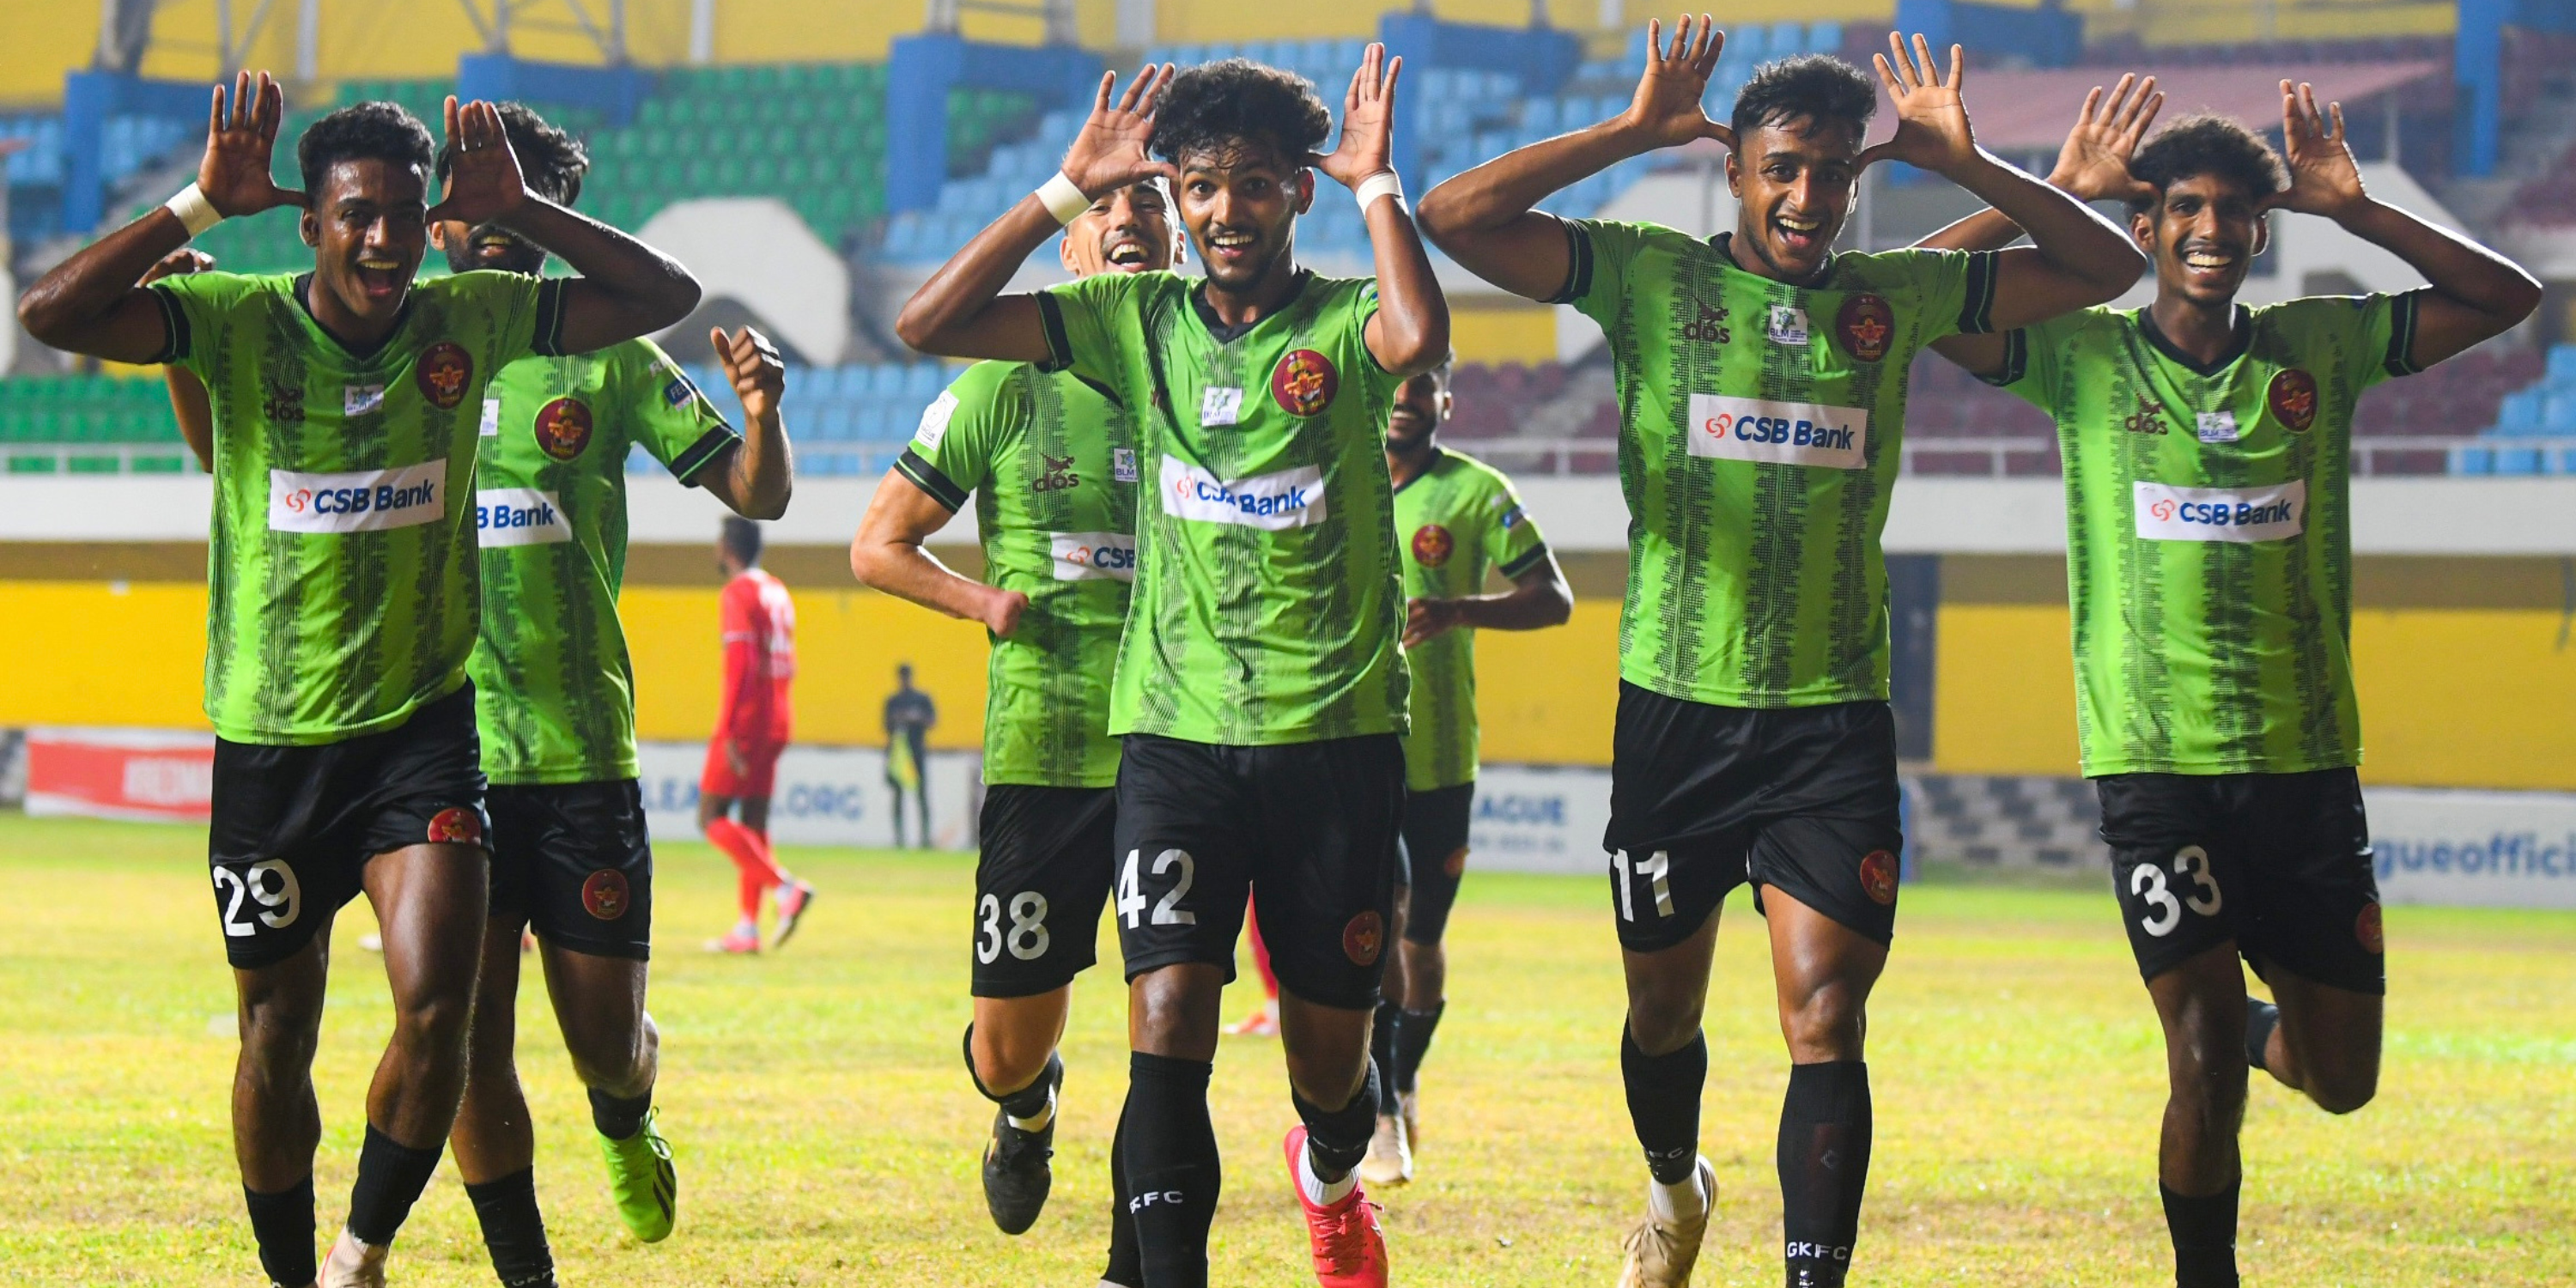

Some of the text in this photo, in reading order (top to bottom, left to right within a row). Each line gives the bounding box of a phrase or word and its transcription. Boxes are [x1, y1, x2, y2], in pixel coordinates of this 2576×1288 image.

[1770, 328, 1789, 337] BLM
[1735, 416, 1856, 450] CSB Bank
[1032, 471, 1080, 493] dos
[1116, 468, 1134, 477] BLM
[314, 478, 434, 514] CSB Bank
[1238, 485, 1306, 515] Bank
[493, 501, 555, 529] Bank
[2179, 499, 2292, 526] CSB Bank
[213, 858, 301, 937] 29
[1117, 848, 1196, 930] 42
[1613, 847, 1675, 922] 11
[2131, 845, 2222, 937] 33
[976, 890, 1050, 964] 38
[1787, 1241, 1848, 1261] GKFC
